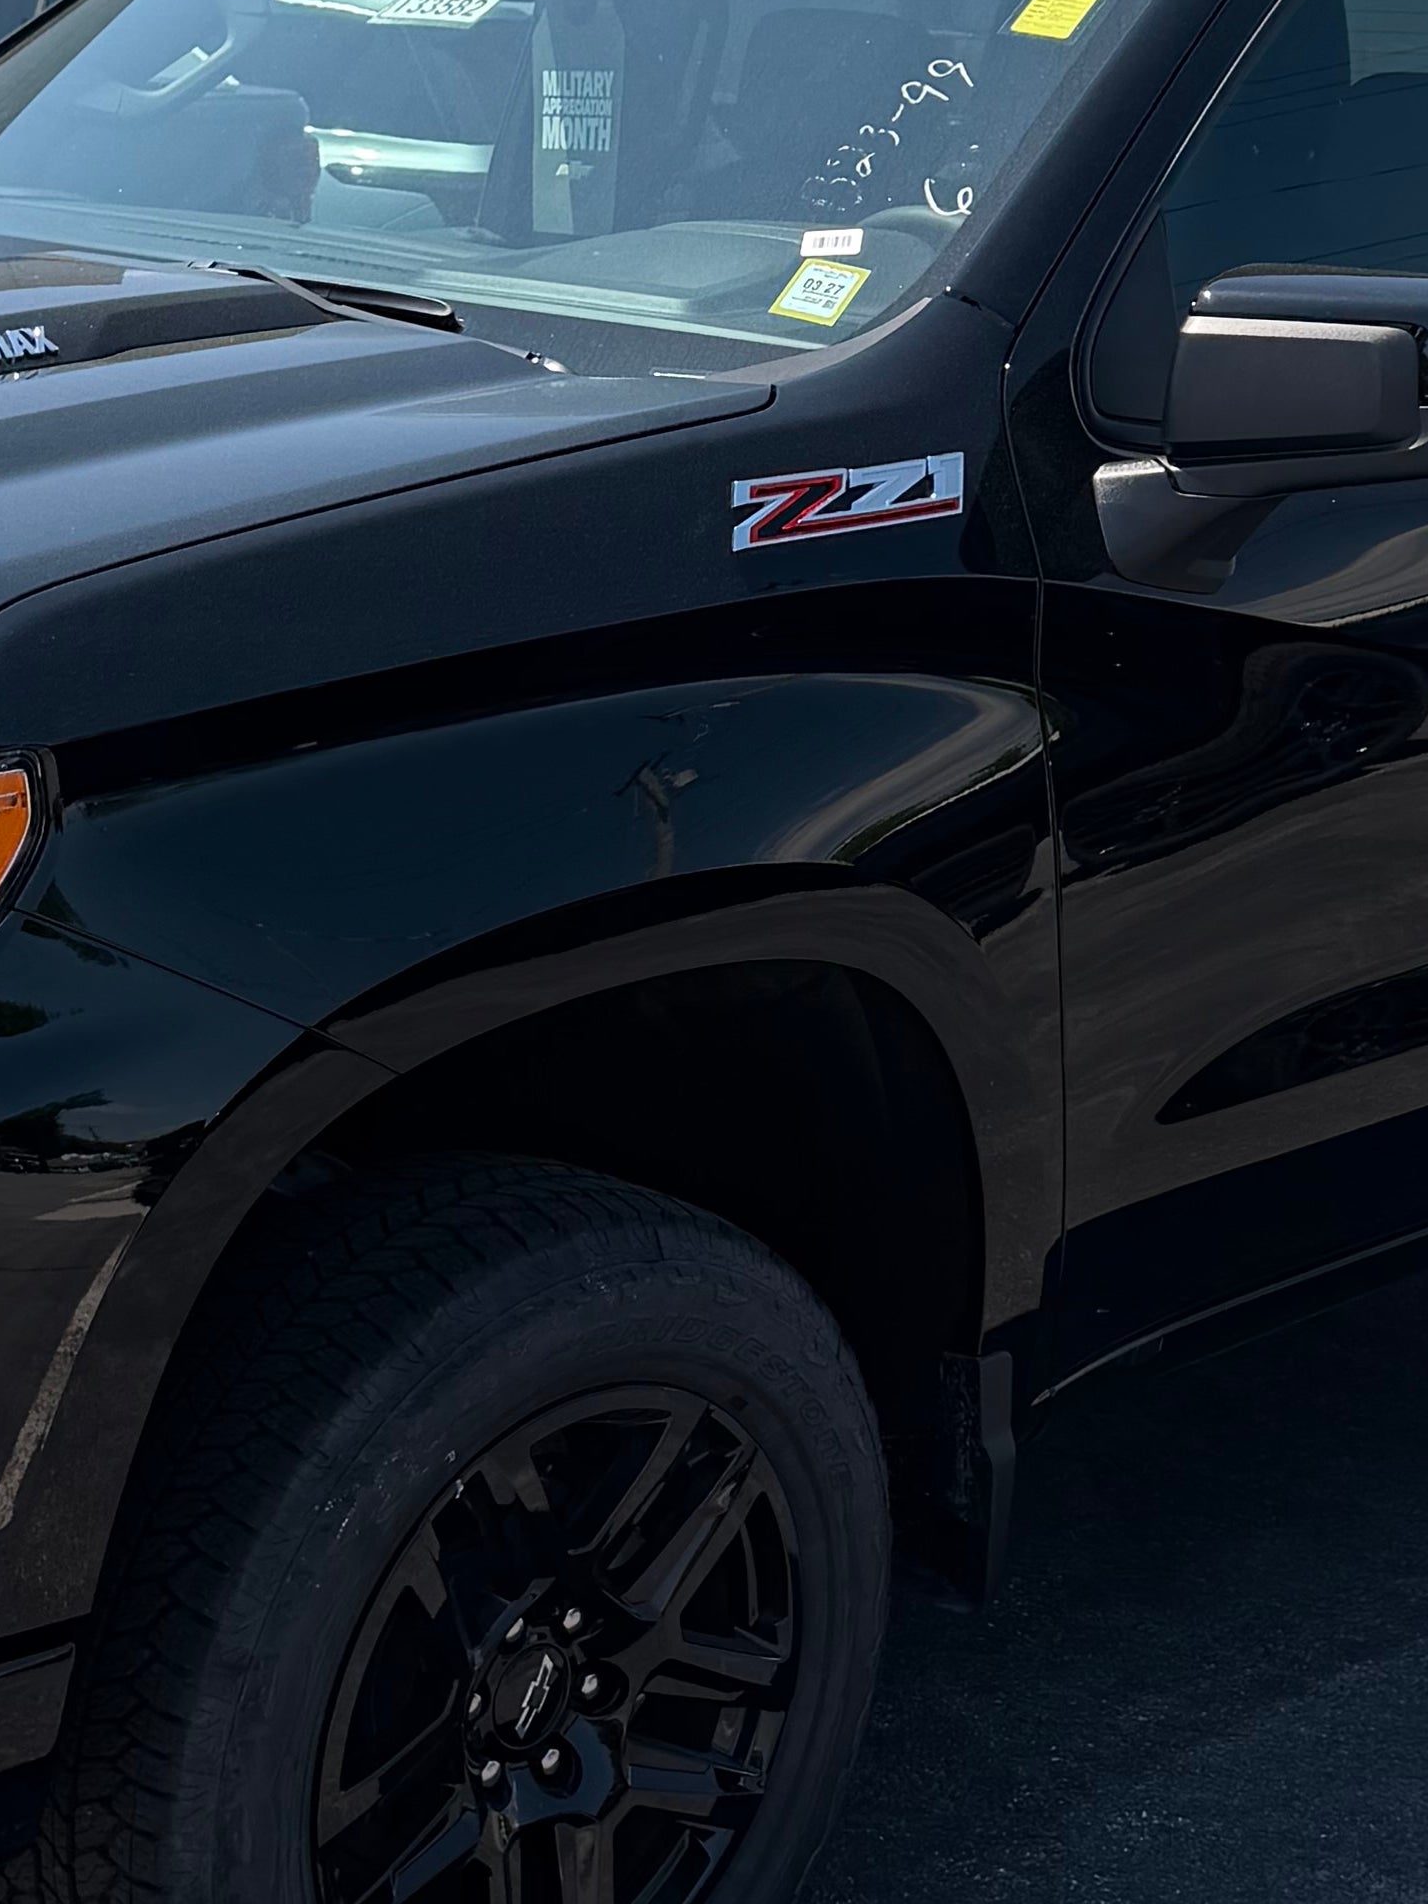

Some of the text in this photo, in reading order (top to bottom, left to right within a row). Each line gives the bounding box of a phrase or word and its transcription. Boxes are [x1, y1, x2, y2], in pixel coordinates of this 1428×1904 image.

[542, 70, 614, 97] MILITARY
[542, 97, 613, 115] APPRECIATION
[542, 115, 613, 152] MONTH
[802, 277, 846, 295] 03 27
[731, 452, 965, 552] Z71
